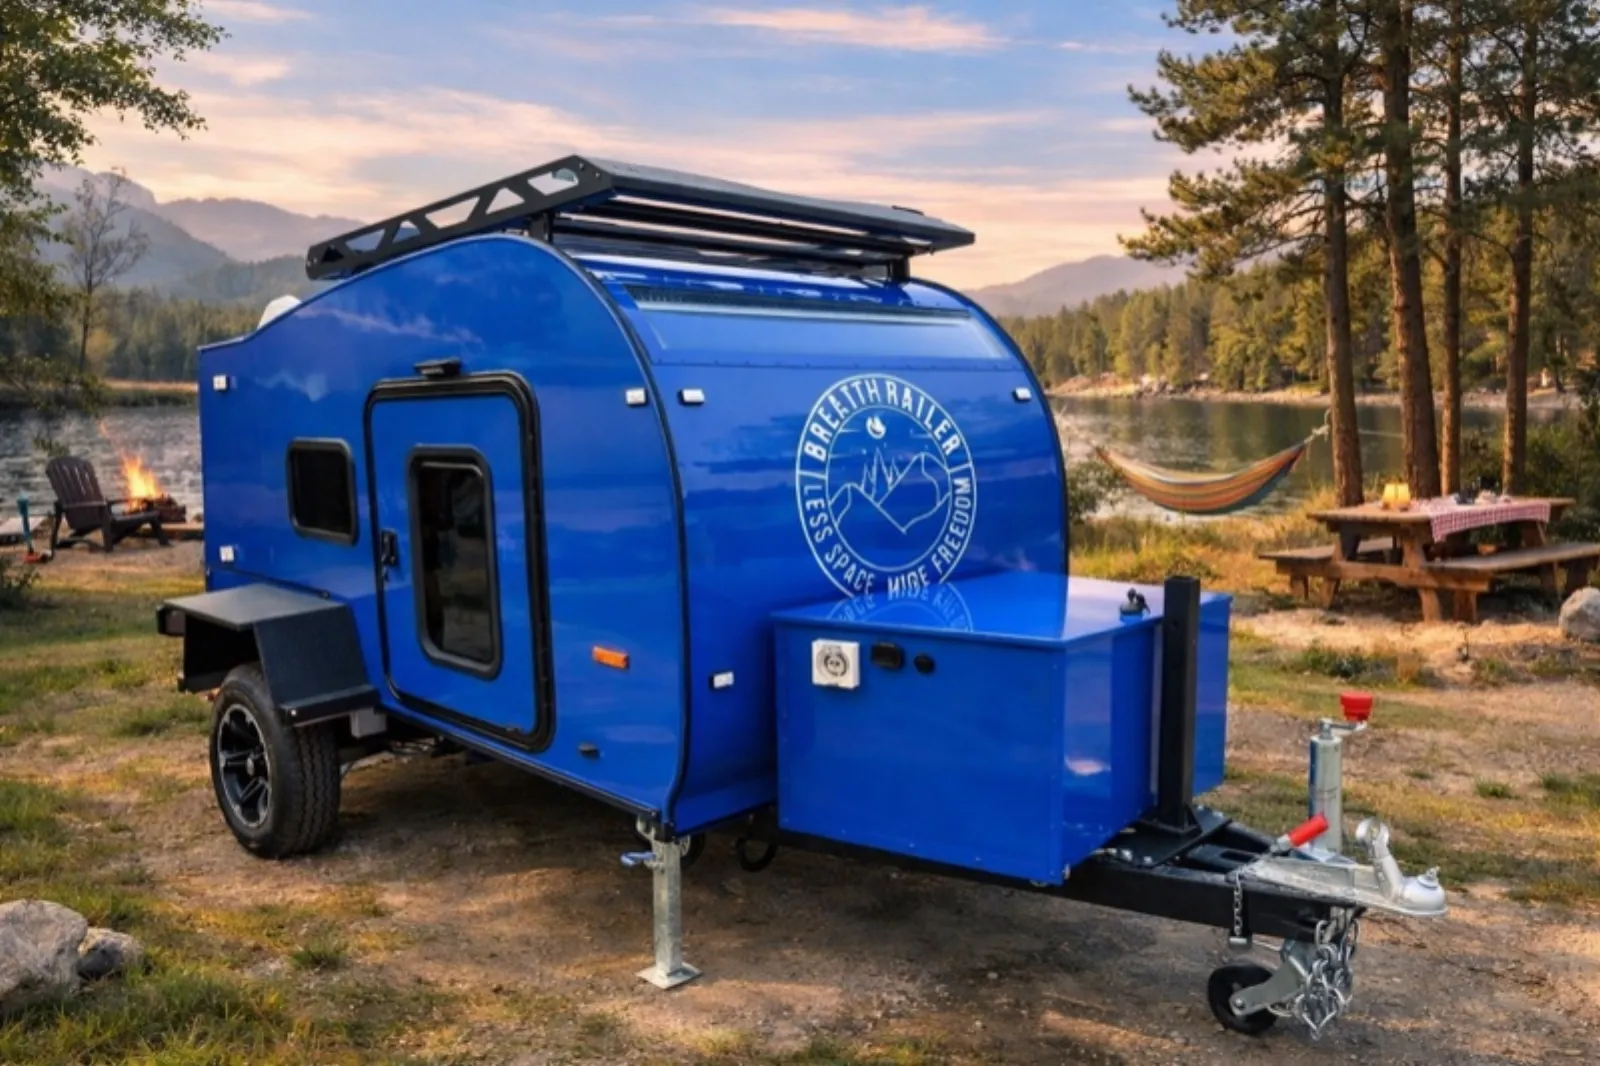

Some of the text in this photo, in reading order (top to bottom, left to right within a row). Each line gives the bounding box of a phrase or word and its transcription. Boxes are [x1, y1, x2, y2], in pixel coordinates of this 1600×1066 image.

[804, 485, 833, 543] LESS
[825, 543, 876, 596] SPACE
[931, 477, 971, 575] FREEDOM
